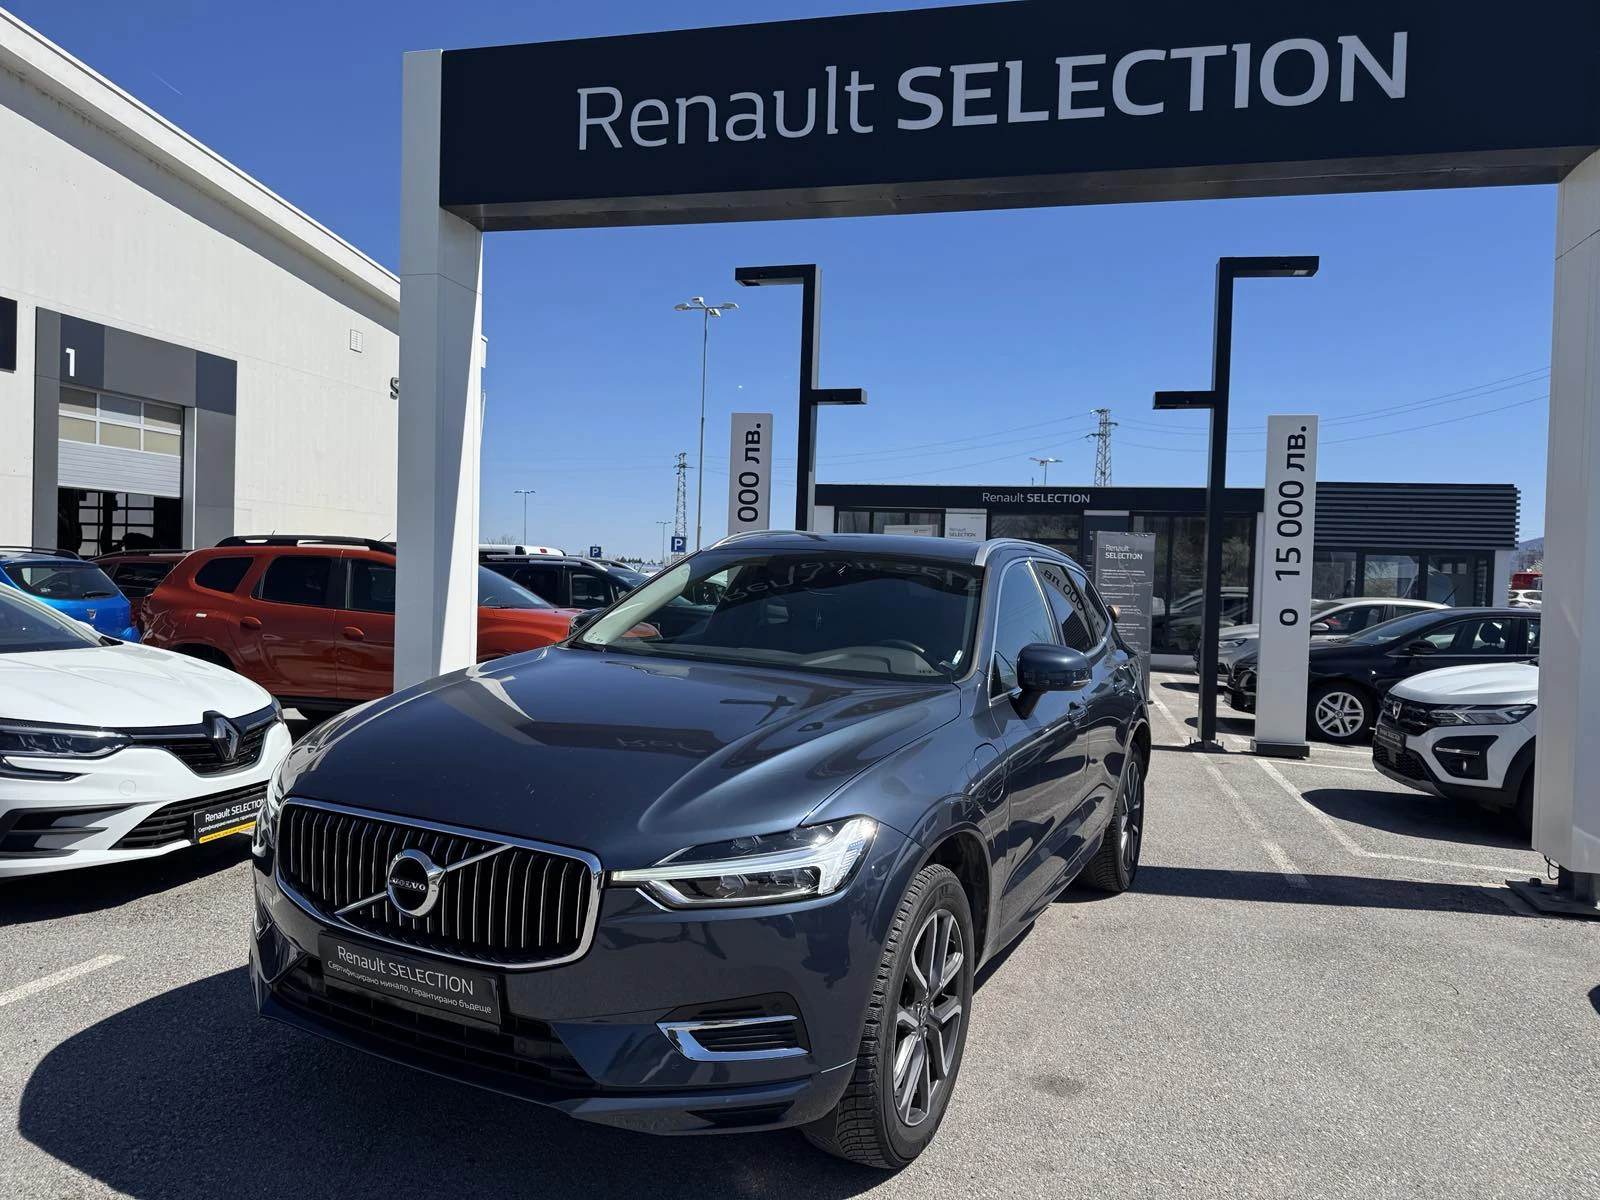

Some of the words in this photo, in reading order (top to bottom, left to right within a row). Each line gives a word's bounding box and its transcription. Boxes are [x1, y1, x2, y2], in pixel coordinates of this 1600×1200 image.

[577, 65, 875, 151] Renault
[897, 31, 1408, 130] SELECTION
[65, 347, 76, 377] 1
[744, 422, 762, 465] лв.
[1286, 425, 1307, 472] лв.
[737, 471, 760, 523] 000
[982, 492, 1025, 503] Renault
[1026, 493, 1090, 504] SELECTION
[1276, 480, 1304, 538] 000
[592, 547, 600, 556] P
[674, 538, 683, 551] P
[1105, 544, 1130, 552] Renault
[1105, 552, 1143, 560] SELECTION
[1275, 547, 1302, 582] 15
[205, 808, 231, 823] Renault
[391, 878, 426, 891] VOLVO
[337, 945, 386, 974] Renault
[388, 962, 474, 996] SELECTION
[327, 960, 379, 986] Сертифицирано
[380, 980, 411, 994] минало,
[411, 988, 458, 1007] гарантирано
[458, 999, 492, 1014] бъдеще
